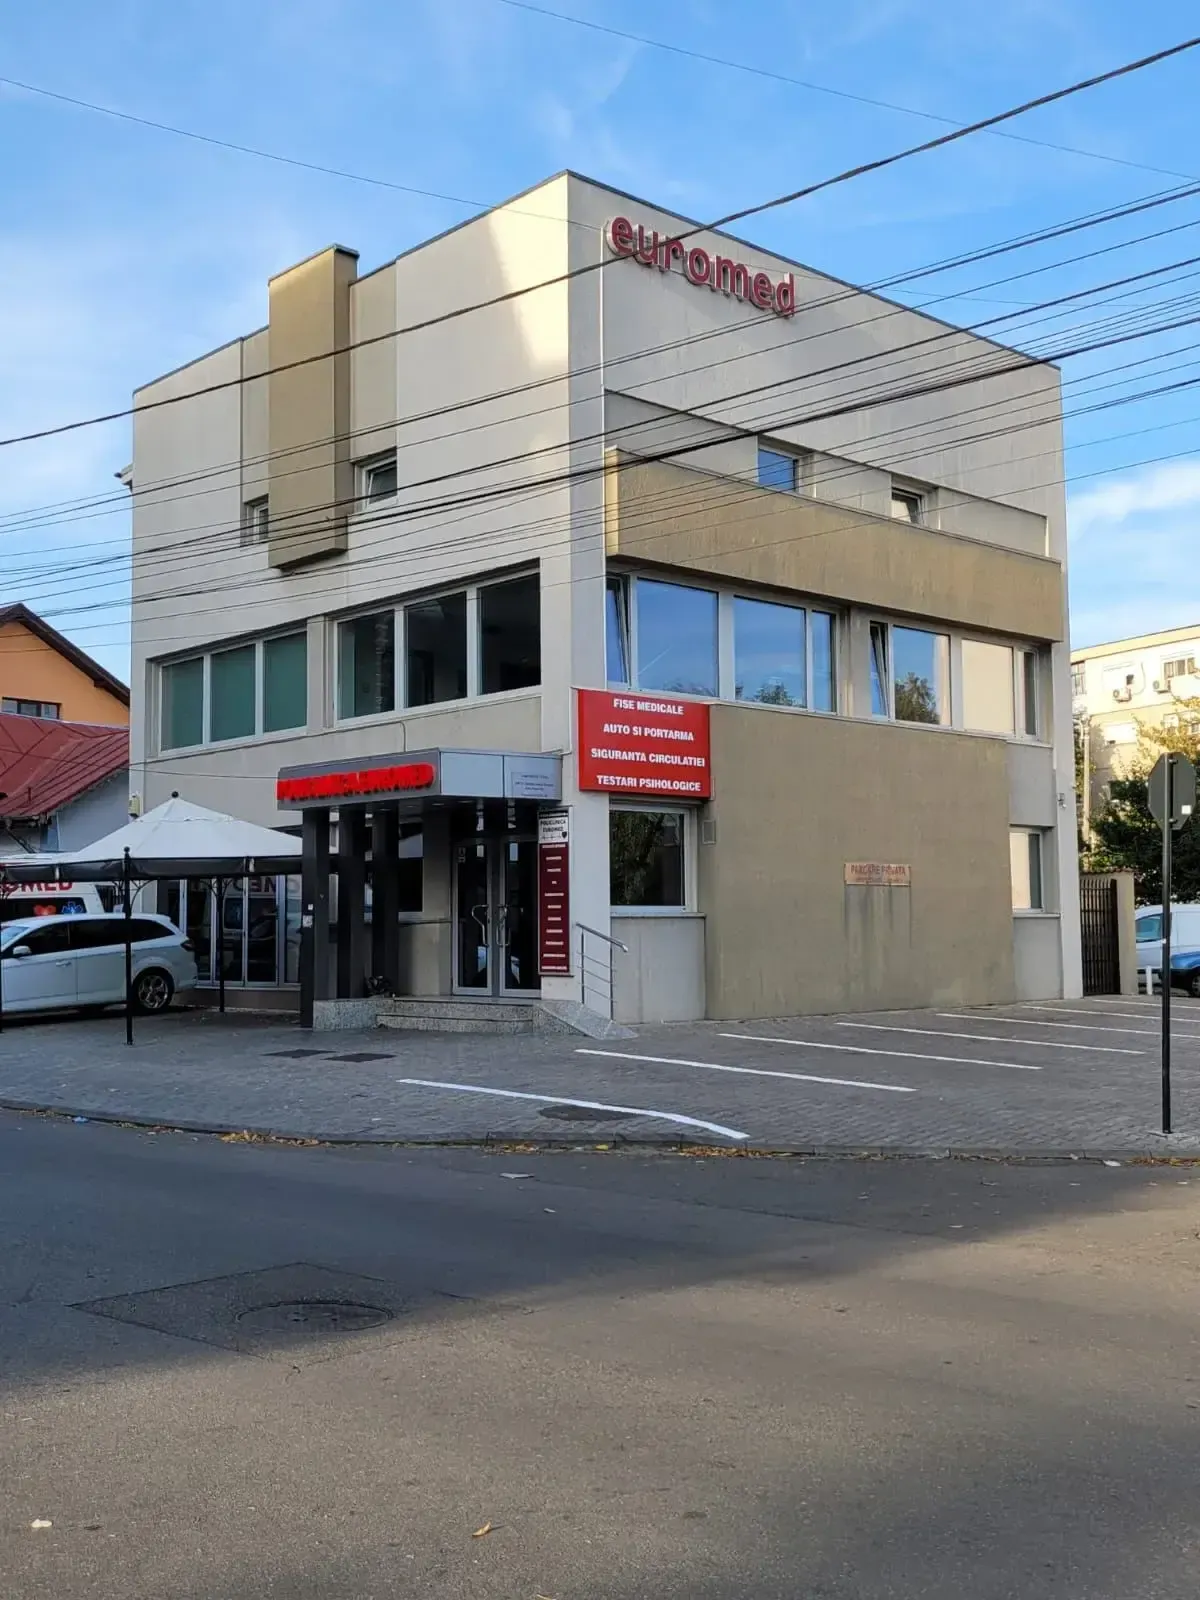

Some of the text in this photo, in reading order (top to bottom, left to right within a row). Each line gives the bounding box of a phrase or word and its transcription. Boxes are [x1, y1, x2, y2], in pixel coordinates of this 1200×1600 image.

[606, 216, 796, 318] euromed
[613, 698, 684, 715] FISE MEDICALE
[603, 723, 694, 741] AUTO SI PORTARMA
[591, 747, 705, 767] SIGURANTA CIRCULATIEI
[596, 774, 701, 792] TESTARI PSIHOLOGICE
